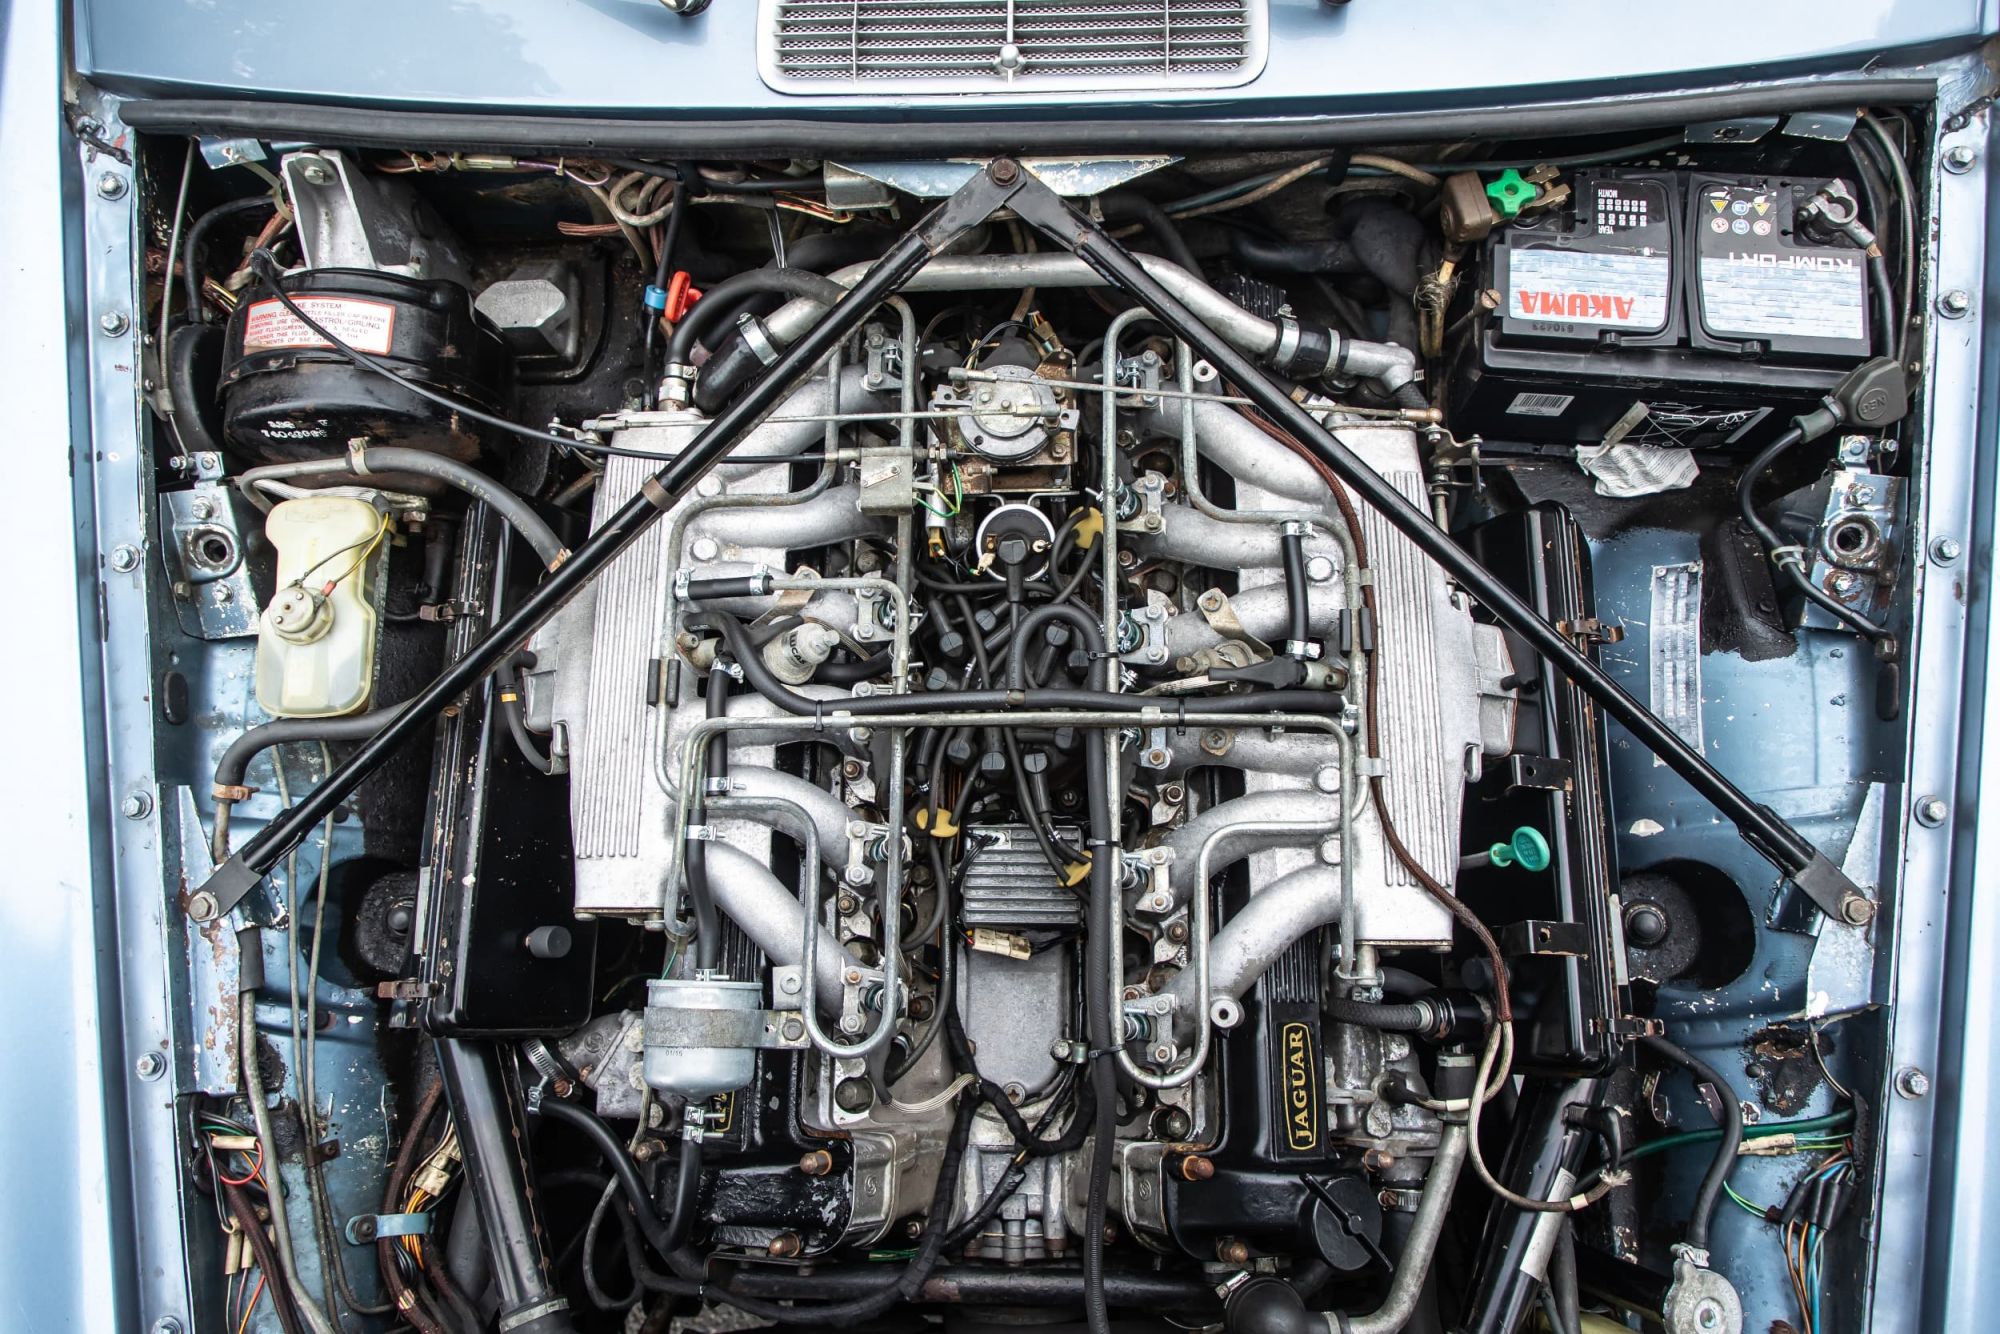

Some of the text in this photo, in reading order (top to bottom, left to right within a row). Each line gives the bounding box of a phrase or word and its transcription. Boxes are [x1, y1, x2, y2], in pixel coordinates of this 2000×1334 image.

[1598, 189, 1618, 197] MONTH
[1598, 225, 1614, 234] YEAR
[1726, 252, 1852, 273] KOMFORT
[1519, 290, 1635, 320] AKUMA
[1863, 396, 1886, 414] NEG
[789, 633, 806, 665] LUCAS
[1289, 1029, 1313, 1143] JAGUAR
